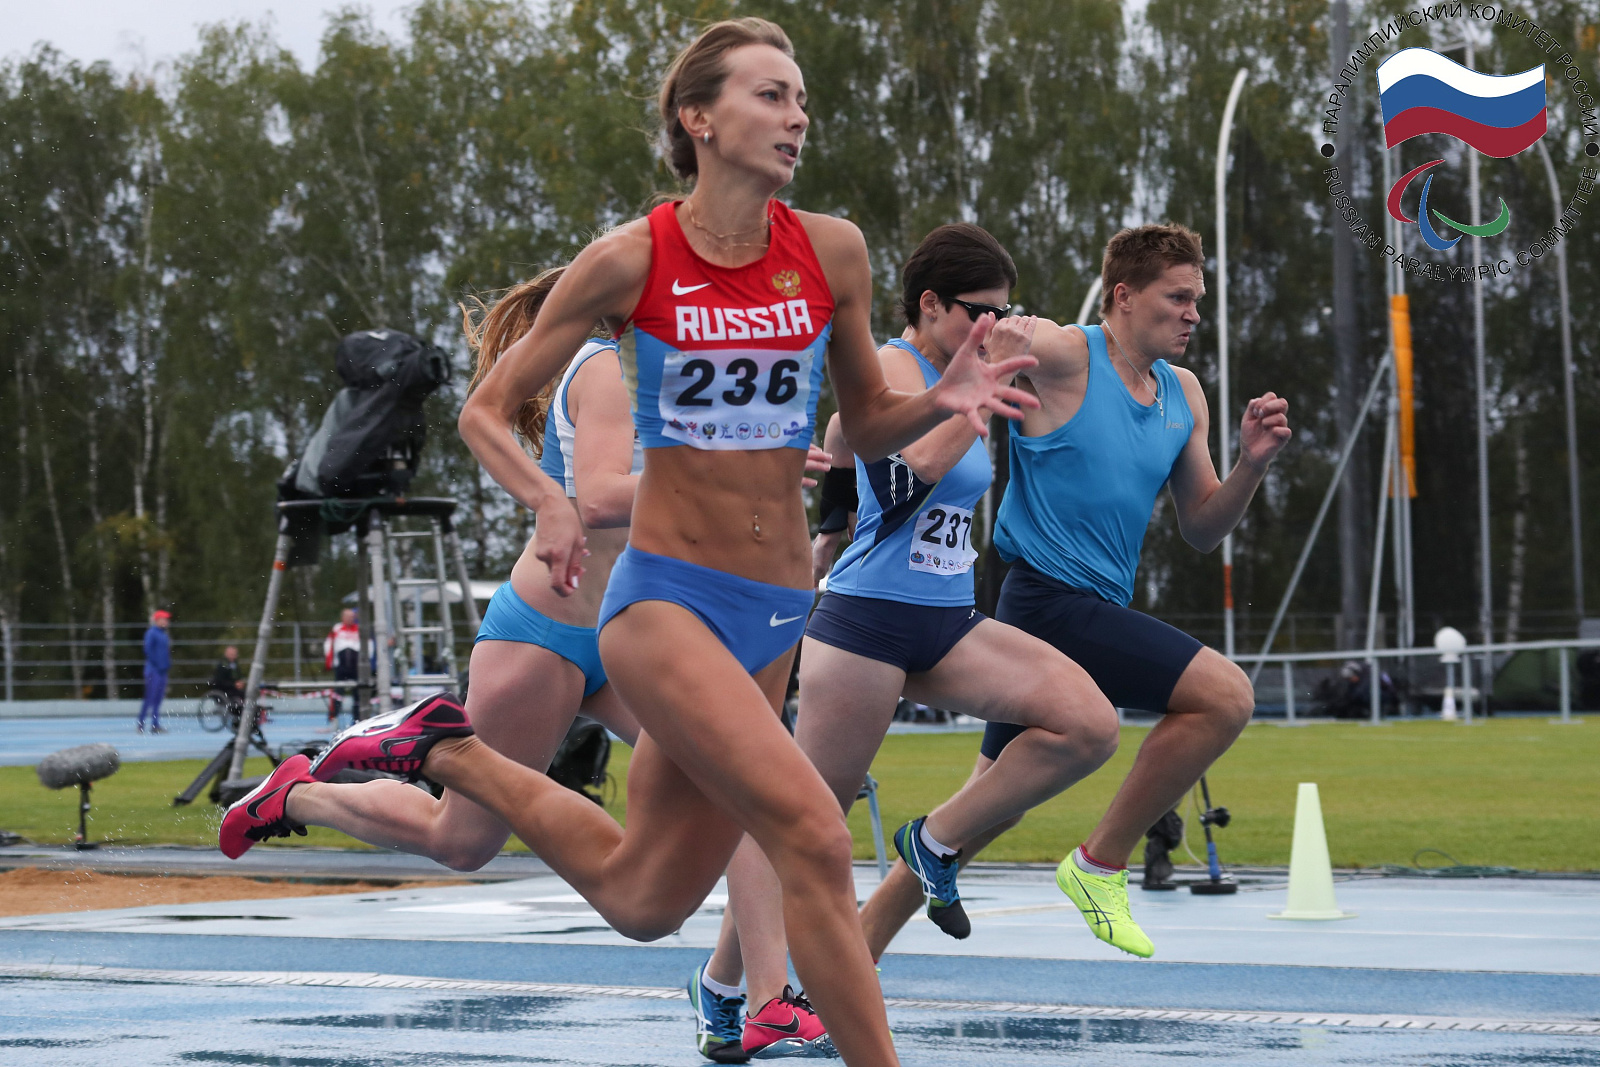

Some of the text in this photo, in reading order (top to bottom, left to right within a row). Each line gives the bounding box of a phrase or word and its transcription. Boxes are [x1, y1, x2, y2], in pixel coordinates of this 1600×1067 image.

[675, 299, 813, 341] RUSSIA
[675, 358, 800, 407] 236
[920, 508, 972, 551] 237
